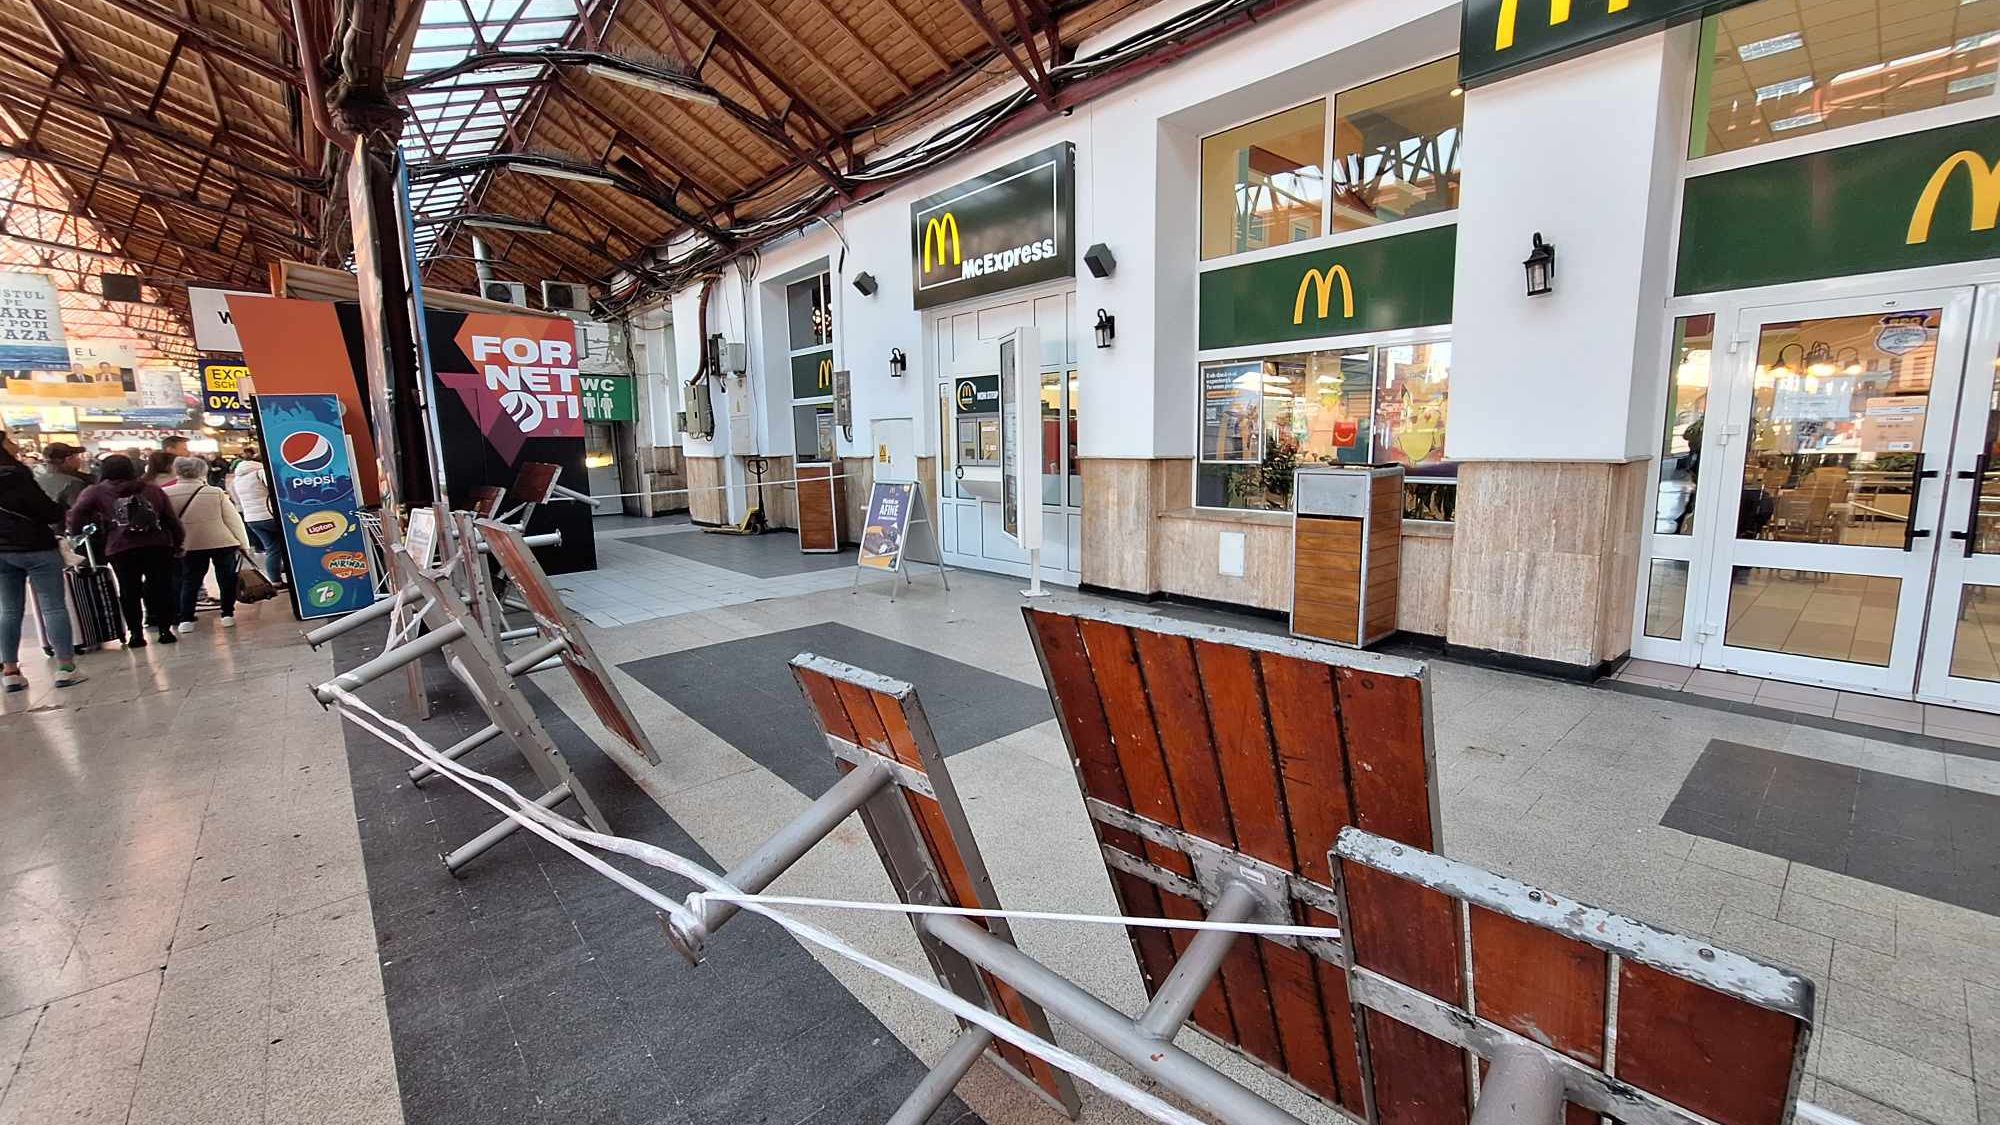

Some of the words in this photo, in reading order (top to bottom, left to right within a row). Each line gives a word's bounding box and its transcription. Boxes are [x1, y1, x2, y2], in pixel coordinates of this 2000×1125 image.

[961, 238, 1054, 280] McExpress
[471, 335, 572, 365] FOR
[214, 380, 238, 389] SCH
[484, 364, 579, 392] NET
[580, 378, 615, 392] WC
[209, 395, 240, 409] 0%
[292, 473, 335, 488] pepsi
[308, 522, 334, 534] Lipton
[329, 559, 366, 570] MIRINDA
